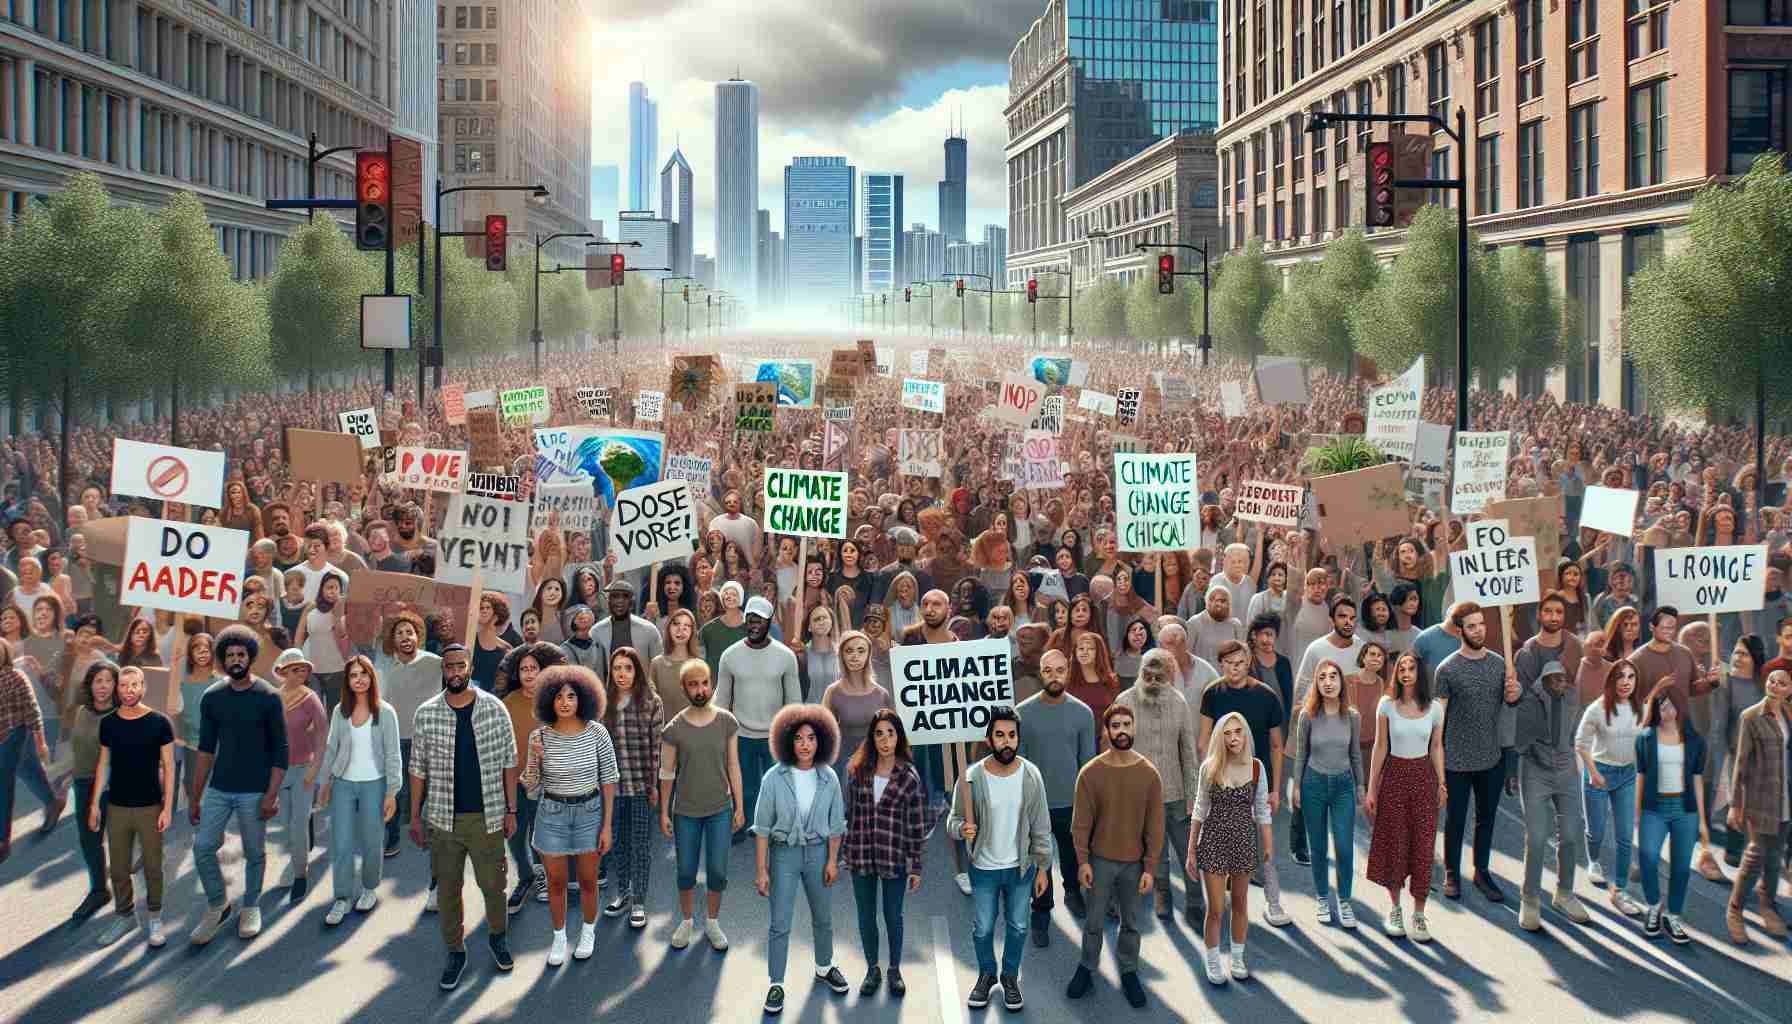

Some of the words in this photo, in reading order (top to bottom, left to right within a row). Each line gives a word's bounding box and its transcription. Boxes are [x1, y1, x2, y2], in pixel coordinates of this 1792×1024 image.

[767, 472, 842, 501] CLIMATE
[1121, 459, 1191, 485] CLIMATE
[618, 486, 689, 526] DOSE
[1128, 490, 1191, 516] CHANGE
[770, 505, 842, 534] CHANGE
[160, 526, 210, 559] DO
[615, 514, 691, 555] VORE!
[1476, 526, 1505, 547] FO
[128, 561, 238, 604] AADER
[1696, 585, 1728, 606] OW
[903, 653, 1008, 682] CLIMATE
[912, 705, 994, 732] ACTIO
